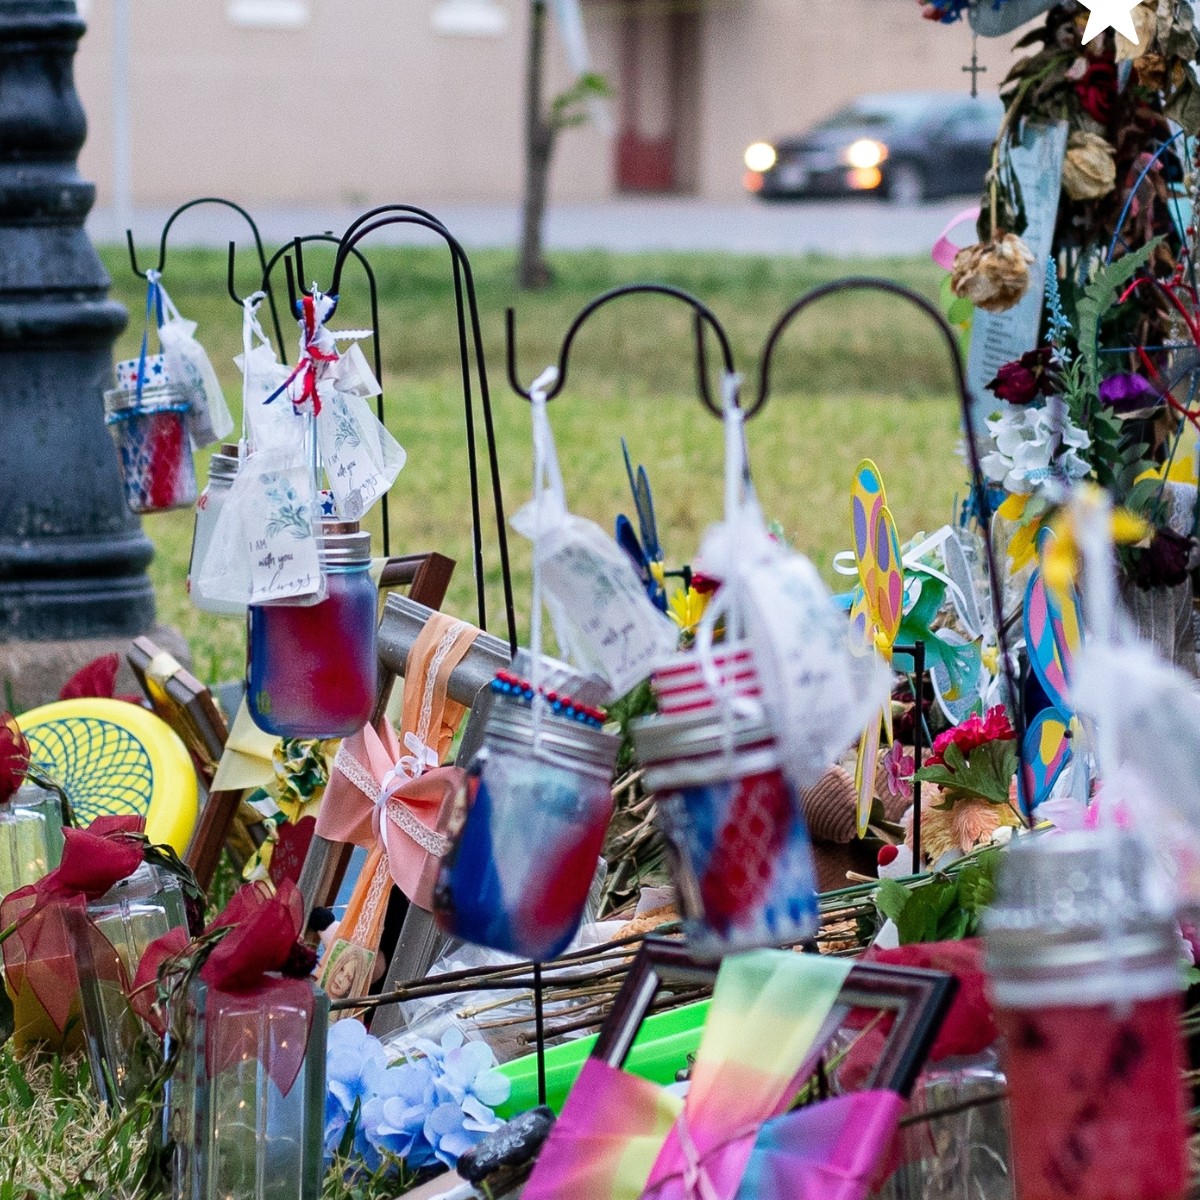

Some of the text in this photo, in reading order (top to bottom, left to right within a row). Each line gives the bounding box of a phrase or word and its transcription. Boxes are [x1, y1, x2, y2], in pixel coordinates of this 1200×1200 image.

[256, 540, 267, 550] AM
[258, 552, 294, 570] with you
